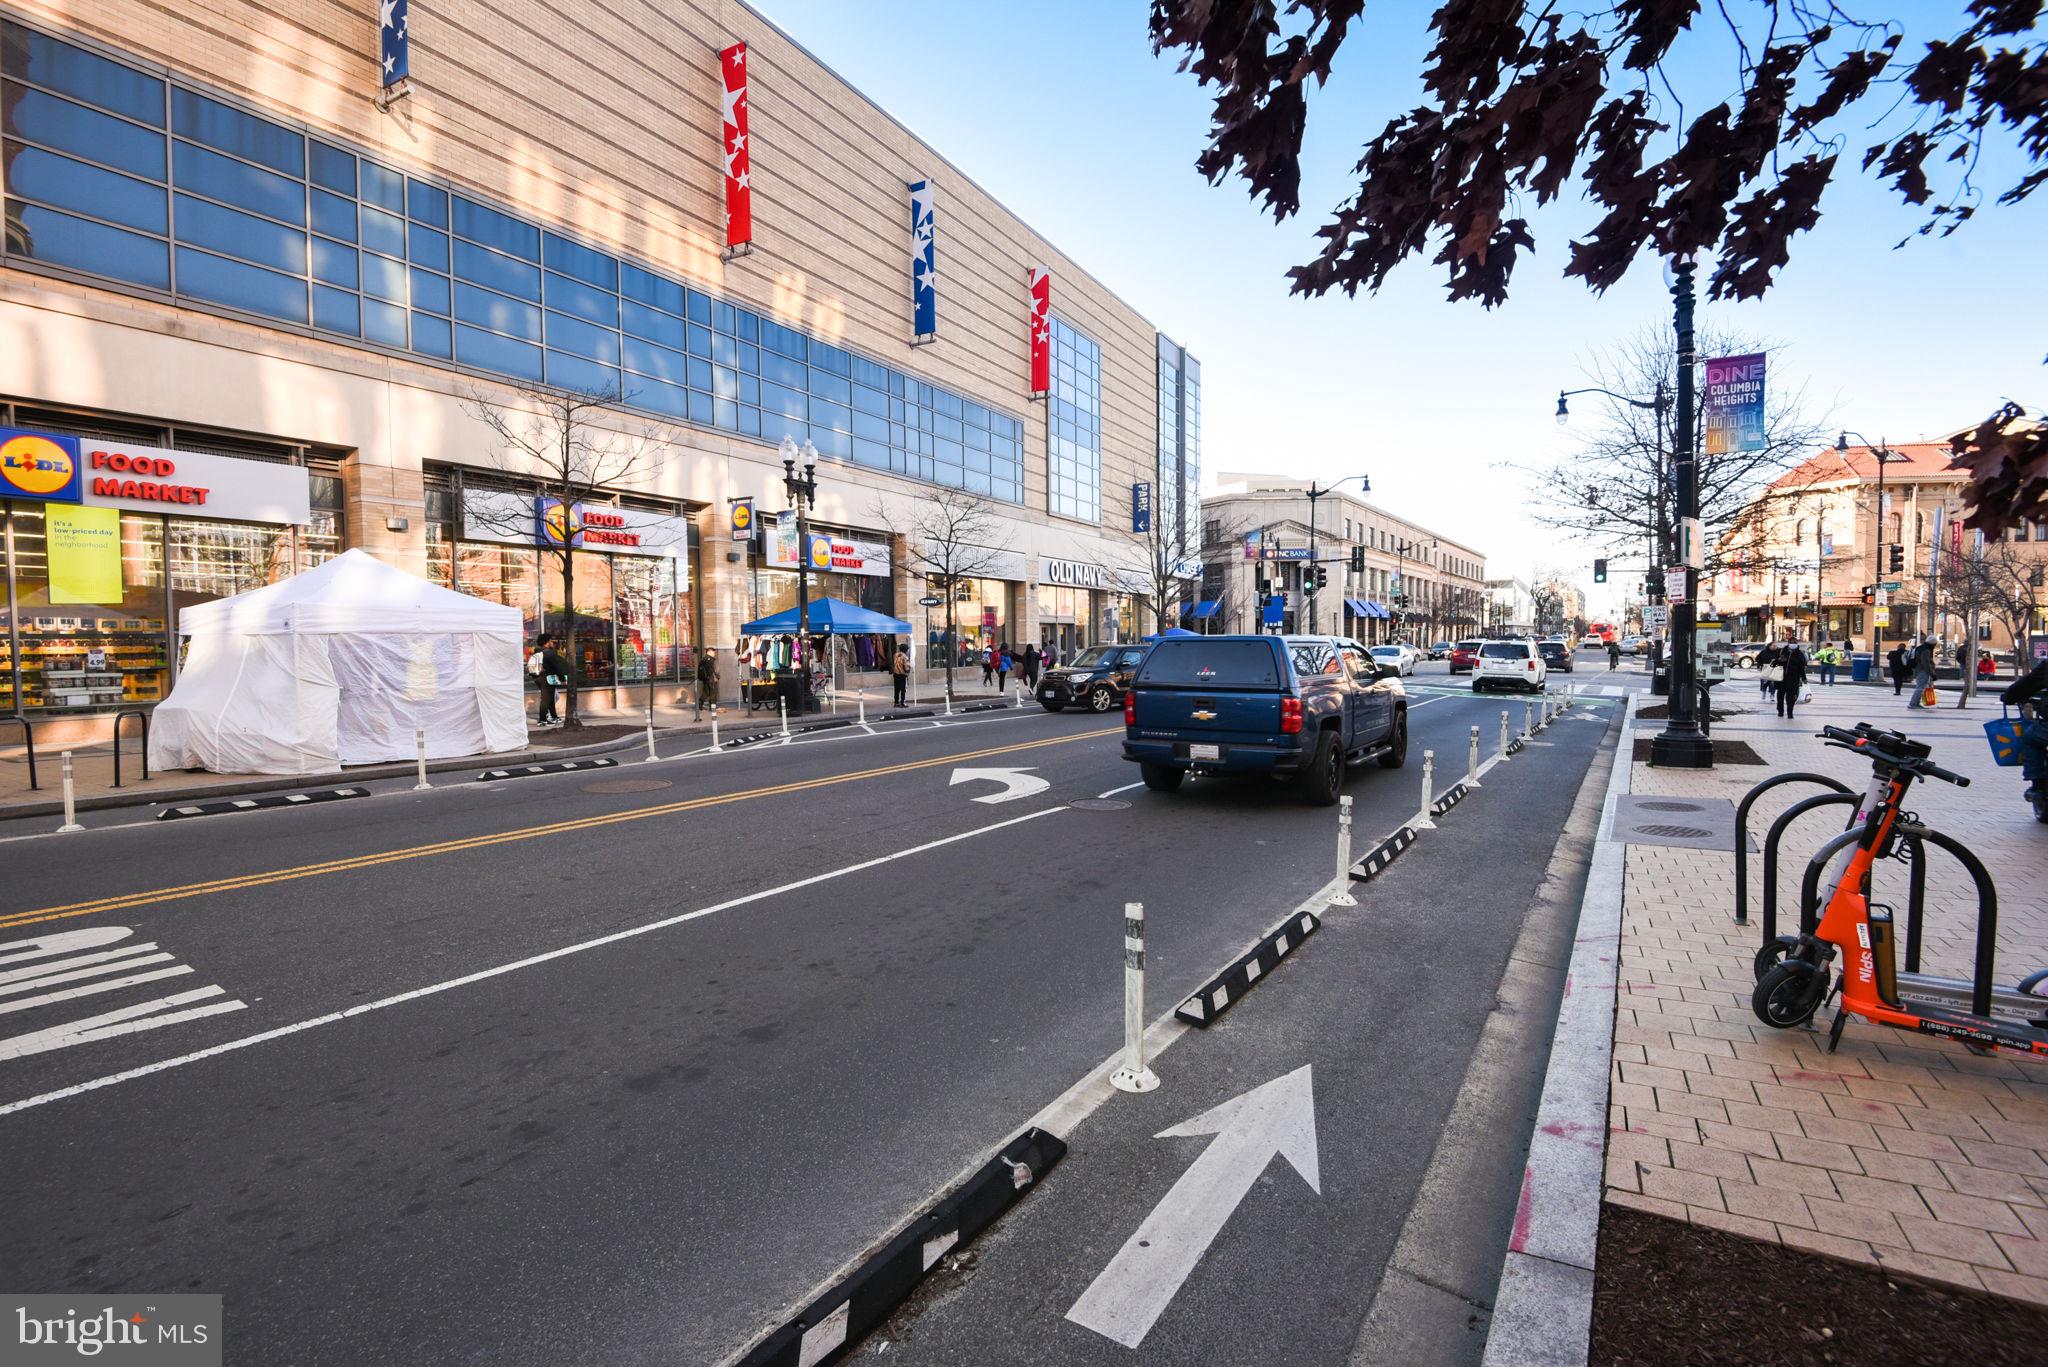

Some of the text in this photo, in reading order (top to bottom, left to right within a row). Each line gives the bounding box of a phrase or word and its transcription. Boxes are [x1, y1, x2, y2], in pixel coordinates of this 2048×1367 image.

[1709, 364, 1764, 384] DINE
[1711, 381, 1761, 396] COLUMBIA
[1714, 393, 1757, 406] HEIGHTS
[91, 451, 175, 476] FOOD
[93, 477, 209, 504] MARKET
[1138, 484, 1149, 512] PARK
[583, 512, 625, 527] FOOD
[584, 530, 640, 546] MARKET
[832, 544, 855, 555] FOOD
[1049, 560, 1103, 587] OLD NAVY
[1859, 951, 1873, 983] SPIN
[1927, 1023, 1950, 1032] (888)
[1952, 1028, 1993, 1041] 249-9698
[1997, 1037, 2031, 1049] spin.app
